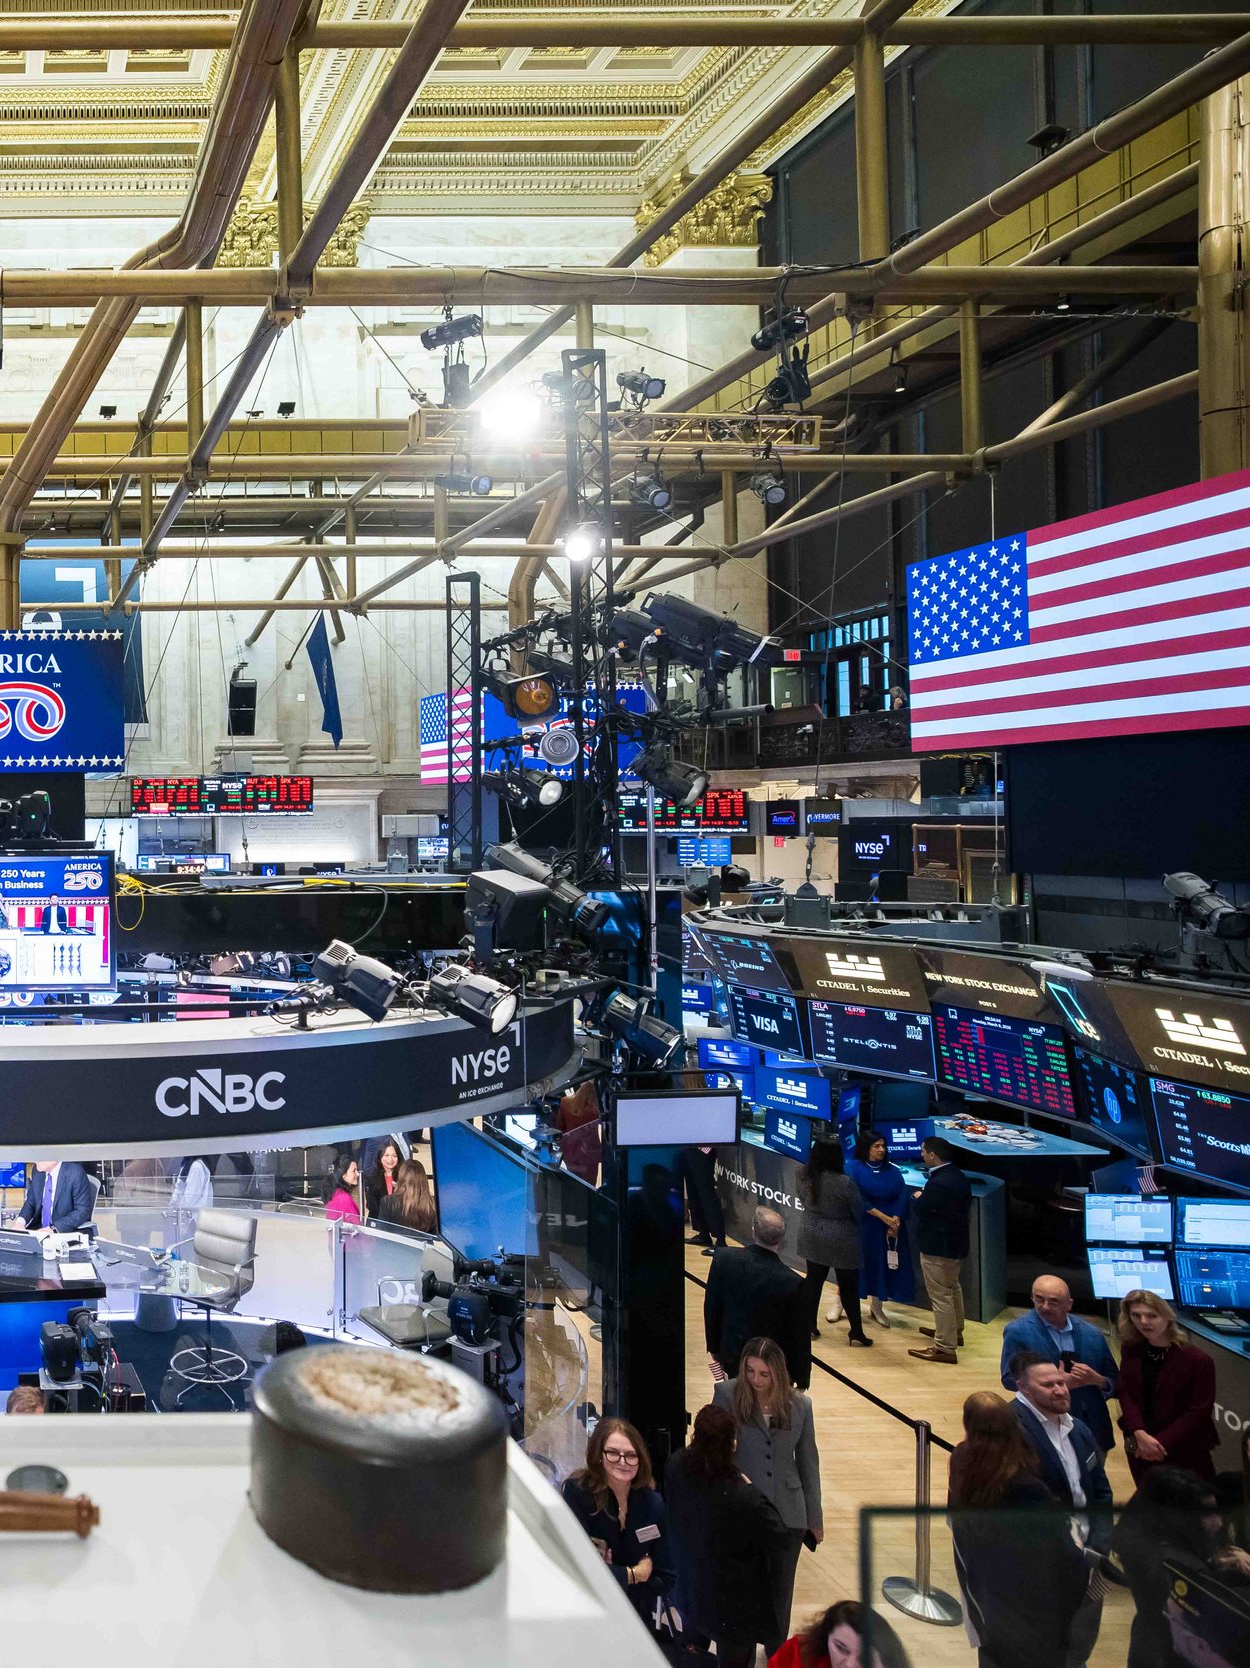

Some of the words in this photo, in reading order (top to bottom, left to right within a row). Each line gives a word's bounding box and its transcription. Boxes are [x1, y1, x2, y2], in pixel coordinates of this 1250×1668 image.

[1, 869, 18, 878] 250
[20, 869, 46, 878] Years
[64, 863, 102, 871] AMERICA
[4, 881, 44, 889] Business
[64, 872, 103, 890] 250
[739, 962, 764, 971] BOEING
[816, 979, 860, 991] CITADEL
[867, 985, 911, 997] Securities
[925, 972, 942, 982] NEW
[944, 974, 964, 986] YORK
[965, 978, 993, 990] STOCK
[993, 982, 1038, 998] EXCHANGE
[812, 1002, 829, 1010] STLA
[750, 1013, 780, 1034] VISA
[842, 1037, 898, 1050] STELLANTIS
[1153, 1046, 1213, 1068] CITADEL
[155, 1068, 286, 1117] CNBC
[459, 1091, 467, 1099] AN
[1156, 1081, 1175, 1093] SMG
[1201, 1090, 1231, 1105] 63.8850
[767, 1094, 791, 1104] CITADEL
[794, 1100, 818, 1110] Securities
[1206, 1135, 1250, 1156] ScottsM
[724, 1166, 749, 1191] YORK
[751, 1181, 791, 1207] STOCK
[0, 1237, 21, 1246] CNBC
